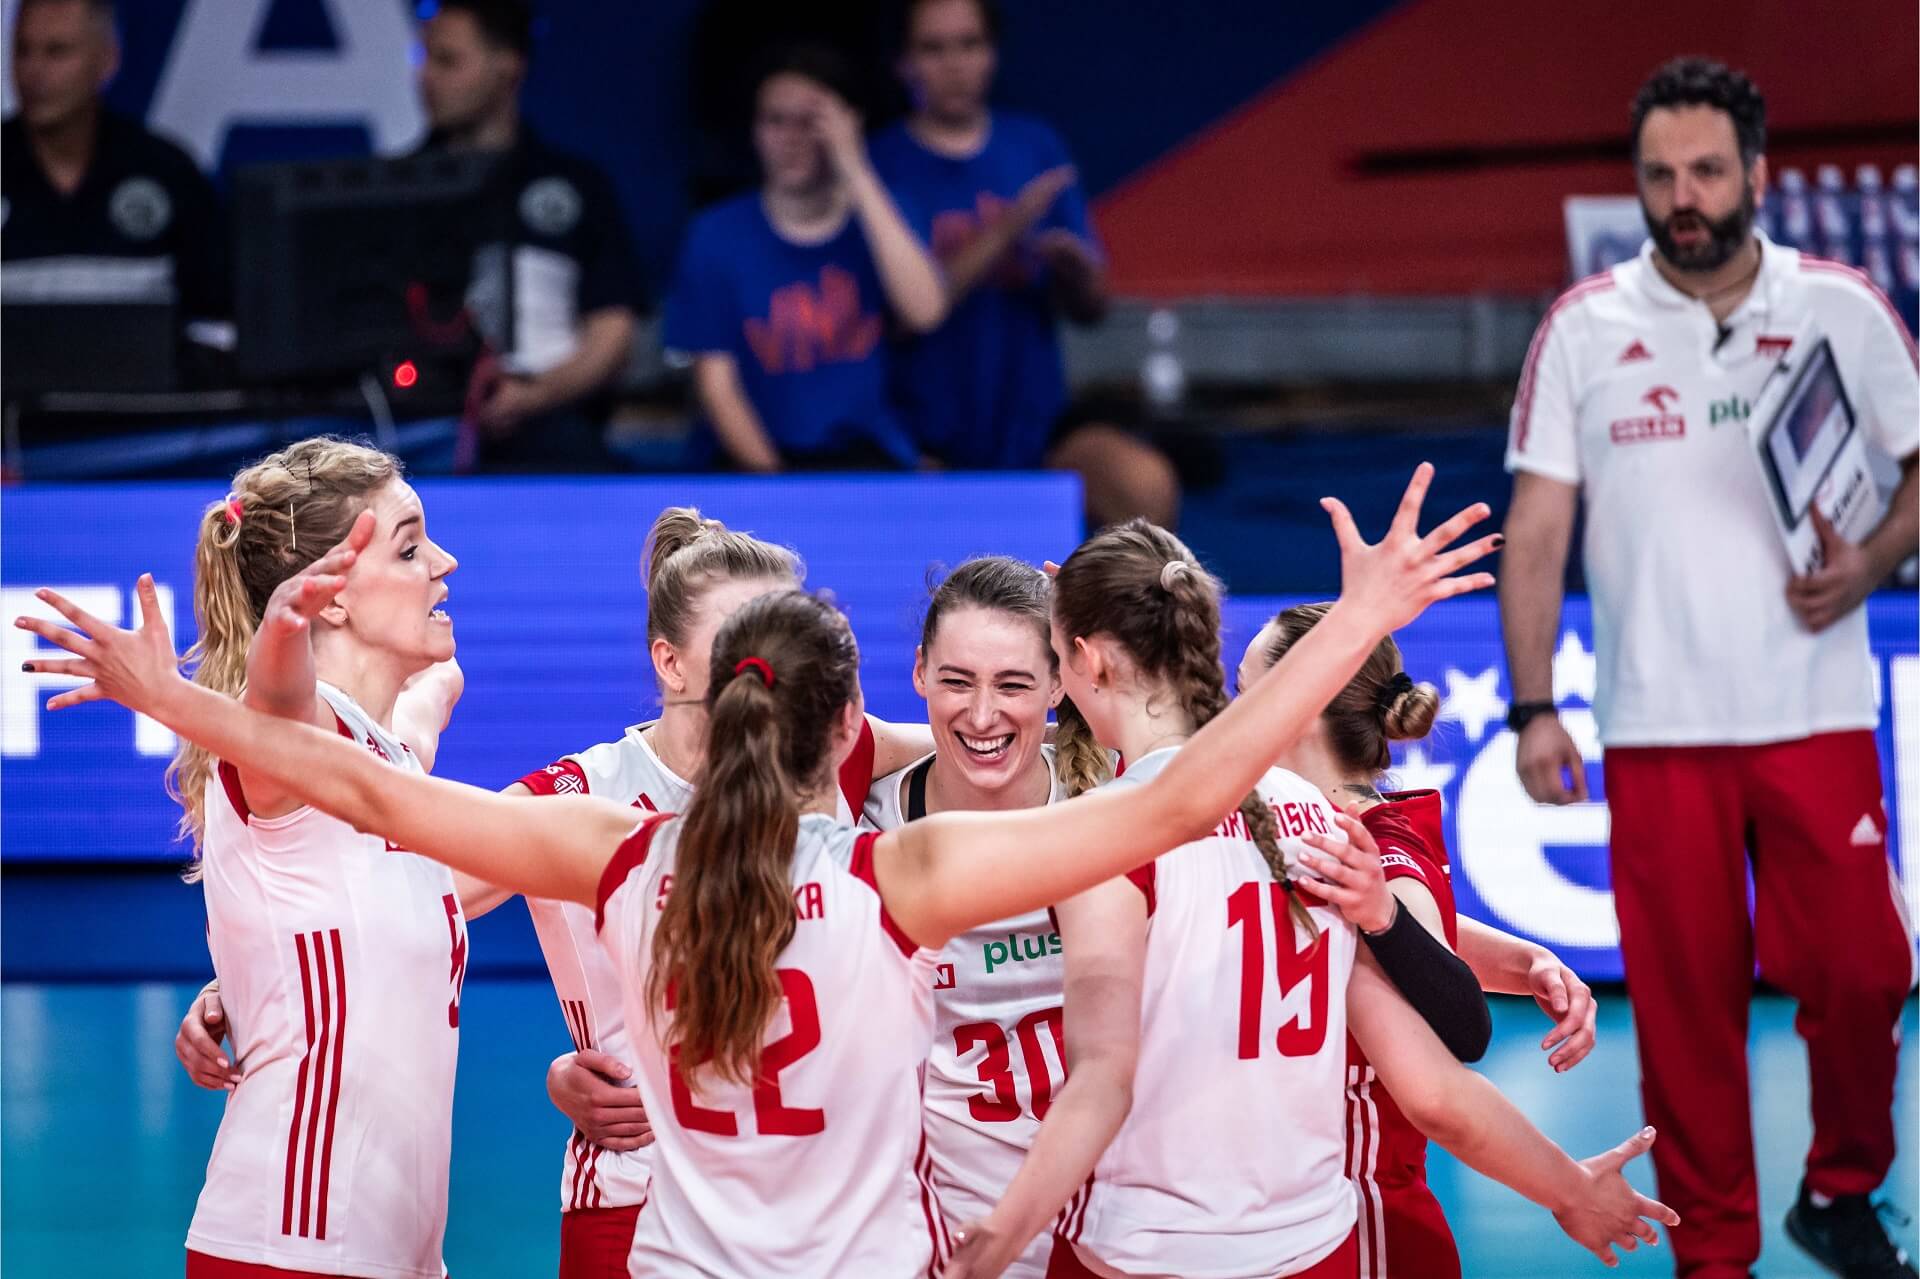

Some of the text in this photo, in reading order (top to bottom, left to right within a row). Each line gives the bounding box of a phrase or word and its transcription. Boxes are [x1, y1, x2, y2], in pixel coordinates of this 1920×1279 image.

[983, 932, 1063, 974] plus
[1227, 878, 1330, 1060] 15
[666, 967, 826, 1137] 22
[953, 1006, 1068, 1122] 30
